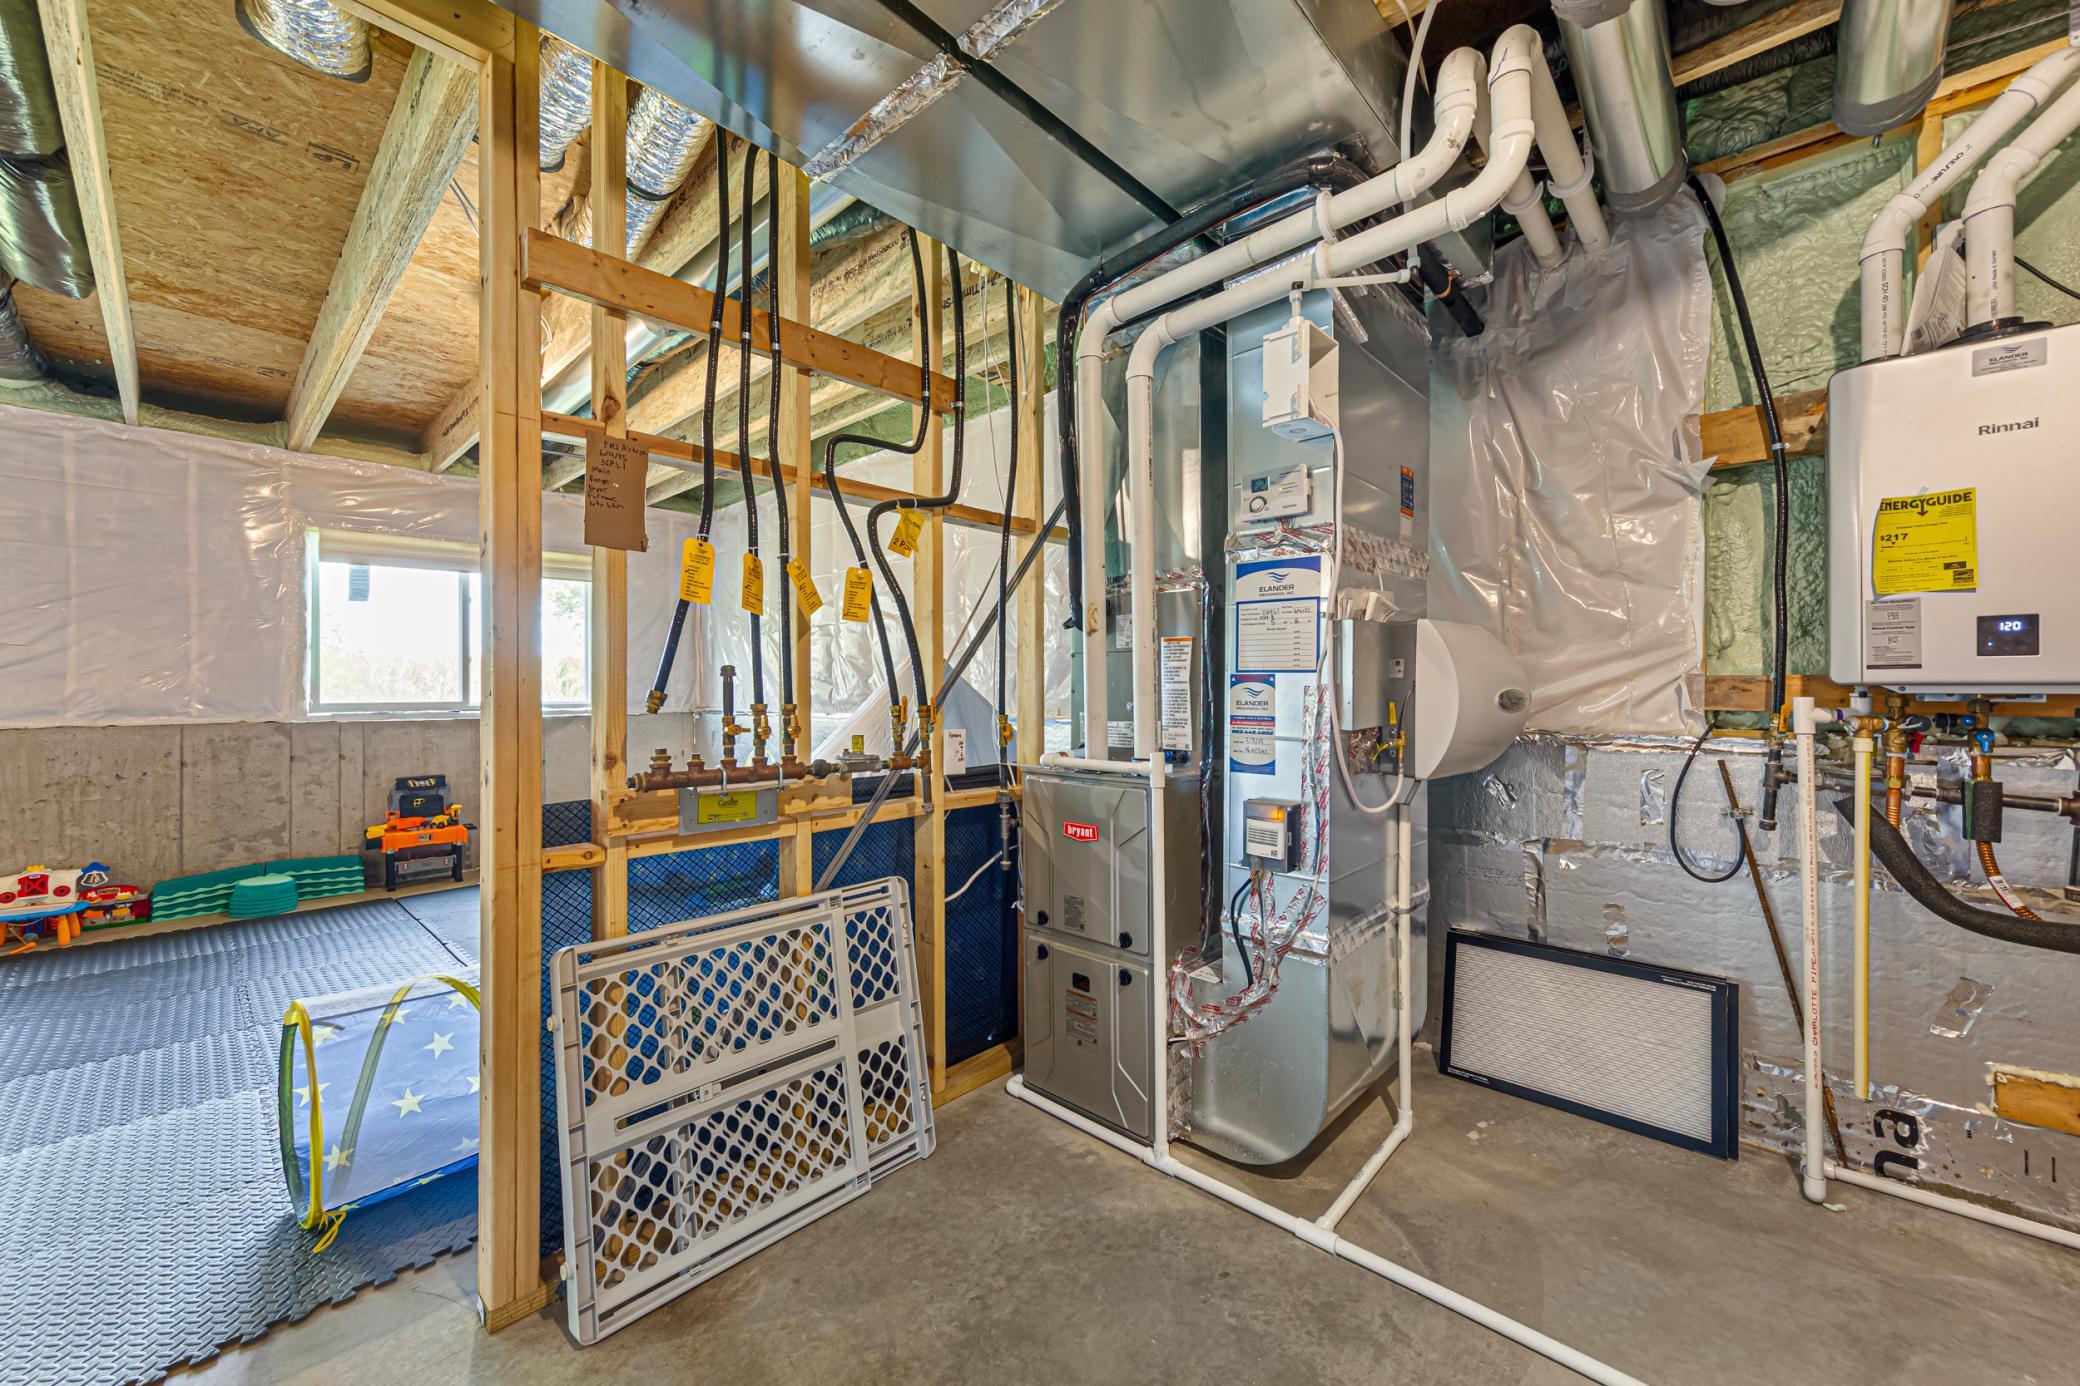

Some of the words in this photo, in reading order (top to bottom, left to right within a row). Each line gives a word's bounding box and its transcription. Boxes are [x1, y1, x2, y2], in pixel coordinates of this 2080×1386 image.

[1989, 351, 2029, 363] ELANDER
[1978, 417, 2040, 436] Rinnai
[1879, 492, 1973, 513] ENERGYGUIDE
[1880, 533, 1909, 542] $217
[1258, 583, 1295, 593] ELANDER
[1999, 621, 2022, 631] 120
[1235, 699, 1269, 707] ELANDER
[1067, 824, 1093, 838] bryant
[1811, 987, 1819, 1046] CHARLOTTE
